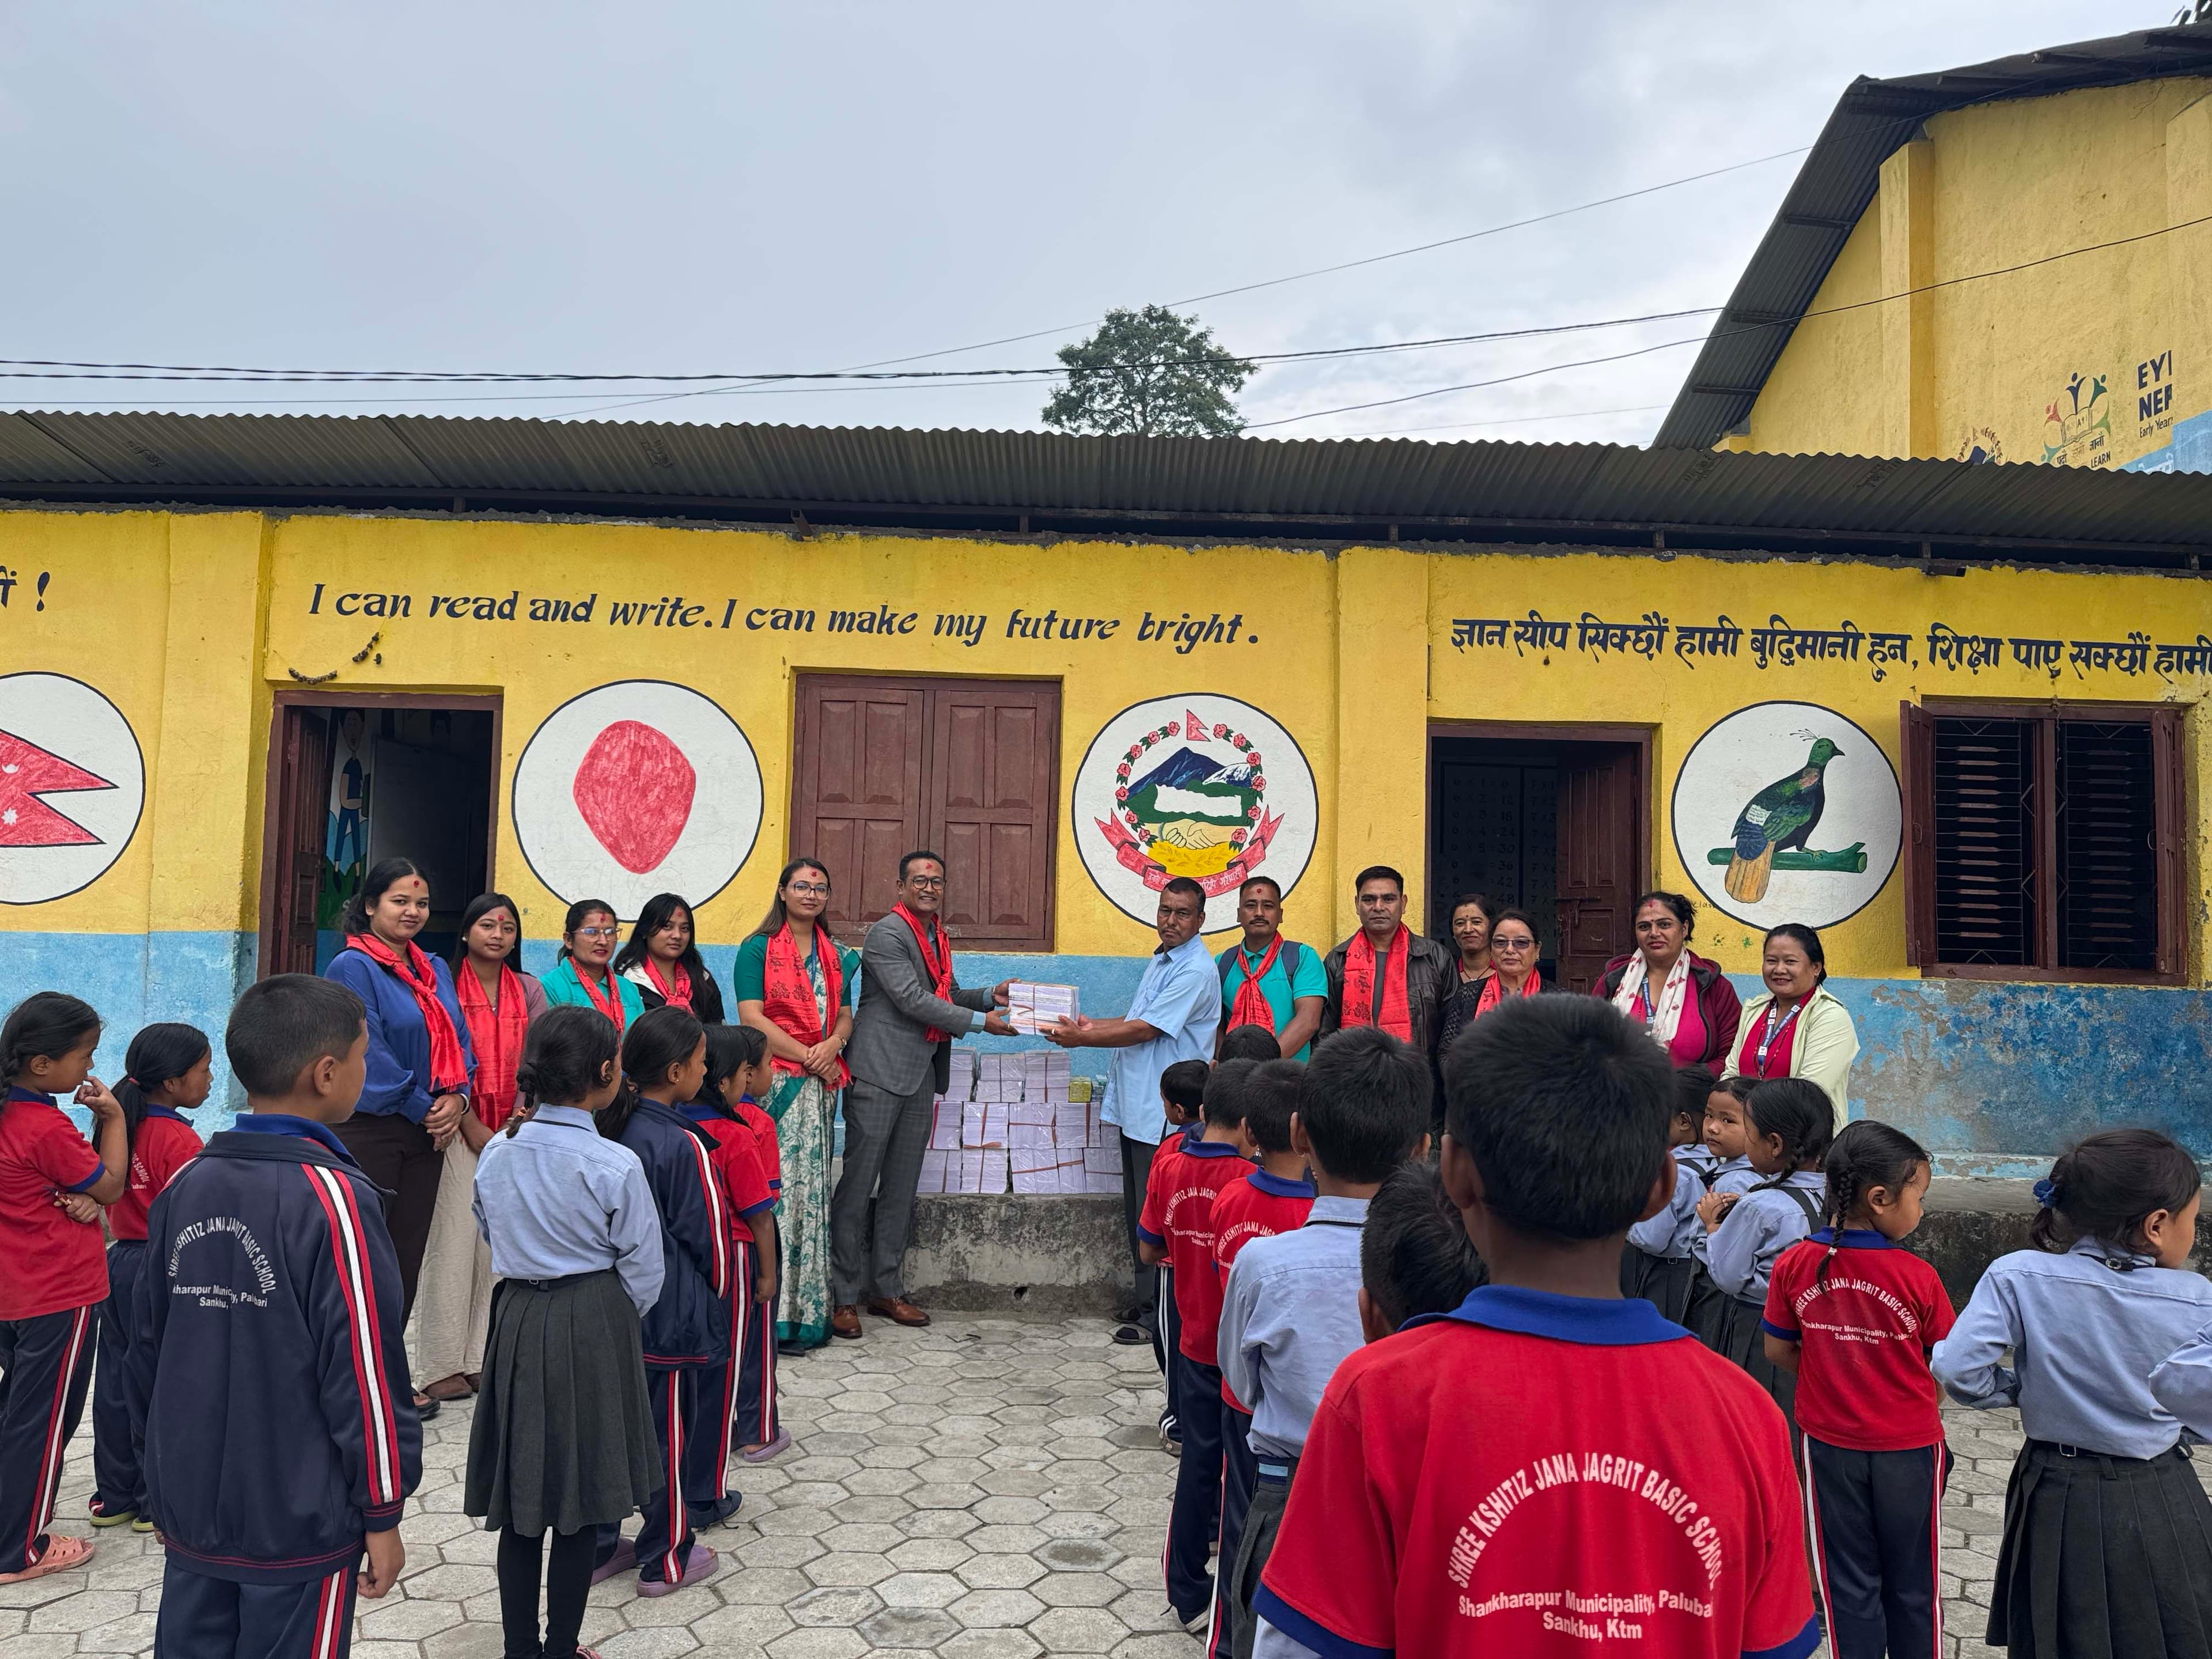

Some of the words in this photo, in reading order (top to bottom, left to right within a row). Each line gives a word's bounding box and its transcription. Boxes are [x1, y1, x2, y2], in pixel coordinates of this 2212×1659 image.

[2139, 422, 2154, 438] Early
[2091, 451, 2111, 468] LEARN
[310, 584, 325, 613] I
[336, 594, 411, 617] can
[430, 591, 518, 620] read
[529, 594, 597, 622] and
[611, 597, 711, 627] write.
[721, 600, 737, 628] I
[746, 609, 815, 632] can
[828, 605, 918, 635] make
[934, 615, 986, 646] my
[1007, 609, 1119, 639] future
[1451, 619, 1512, 654] ज्ञान
[1675, 615, 1744, 669] हामी
[1926, 622, 2004, 675] शिक्षा
[2008, 638, 2066, 679] पाए
[1244, 1221, 1259, 1233] JANA
[241, 1230, 261, 1259] BASIC
[252, 1254, 276, 1294] SCHOOL
[1802, 1281, 1830, 1302] KSHIIZ
[1831, 1277, 1850, 1290] JANA
[1851, 1278, 1880, 1297] JAGRIT
[1878, 1290, 1902, 1311] BASIC
[1897, 1308, 1917, 1333] SCHOOL
[1835, 1332, 1862, 1342] Sankhu,
[1865, 1335, 1878, 1344] Ktm
[1844, 1325, 1888, 1338] Municipality,
[1448, 1525, 1487, 1589] SHREE
[1468, 1469, 1534, 1538] KSHITIZ
[1532, 1453, 1579, 1491] JANA
[1582, 1452, 1645, 1492] JAGRIT
[1641, 1470, 1698, 1524] BASIC
[1685, 1516, 1722, 1592] SCHOOL
[1459, 1591, 1562, 1618] Shankharapur
[1565, 1589, 1655, 1616] Municipality,
[1659, 1590, 1713, 1618] Paluba
[1543, 1611, 1603, 1642] Sankhu,
[1607, 1619, 1642, 1639] Ktm
